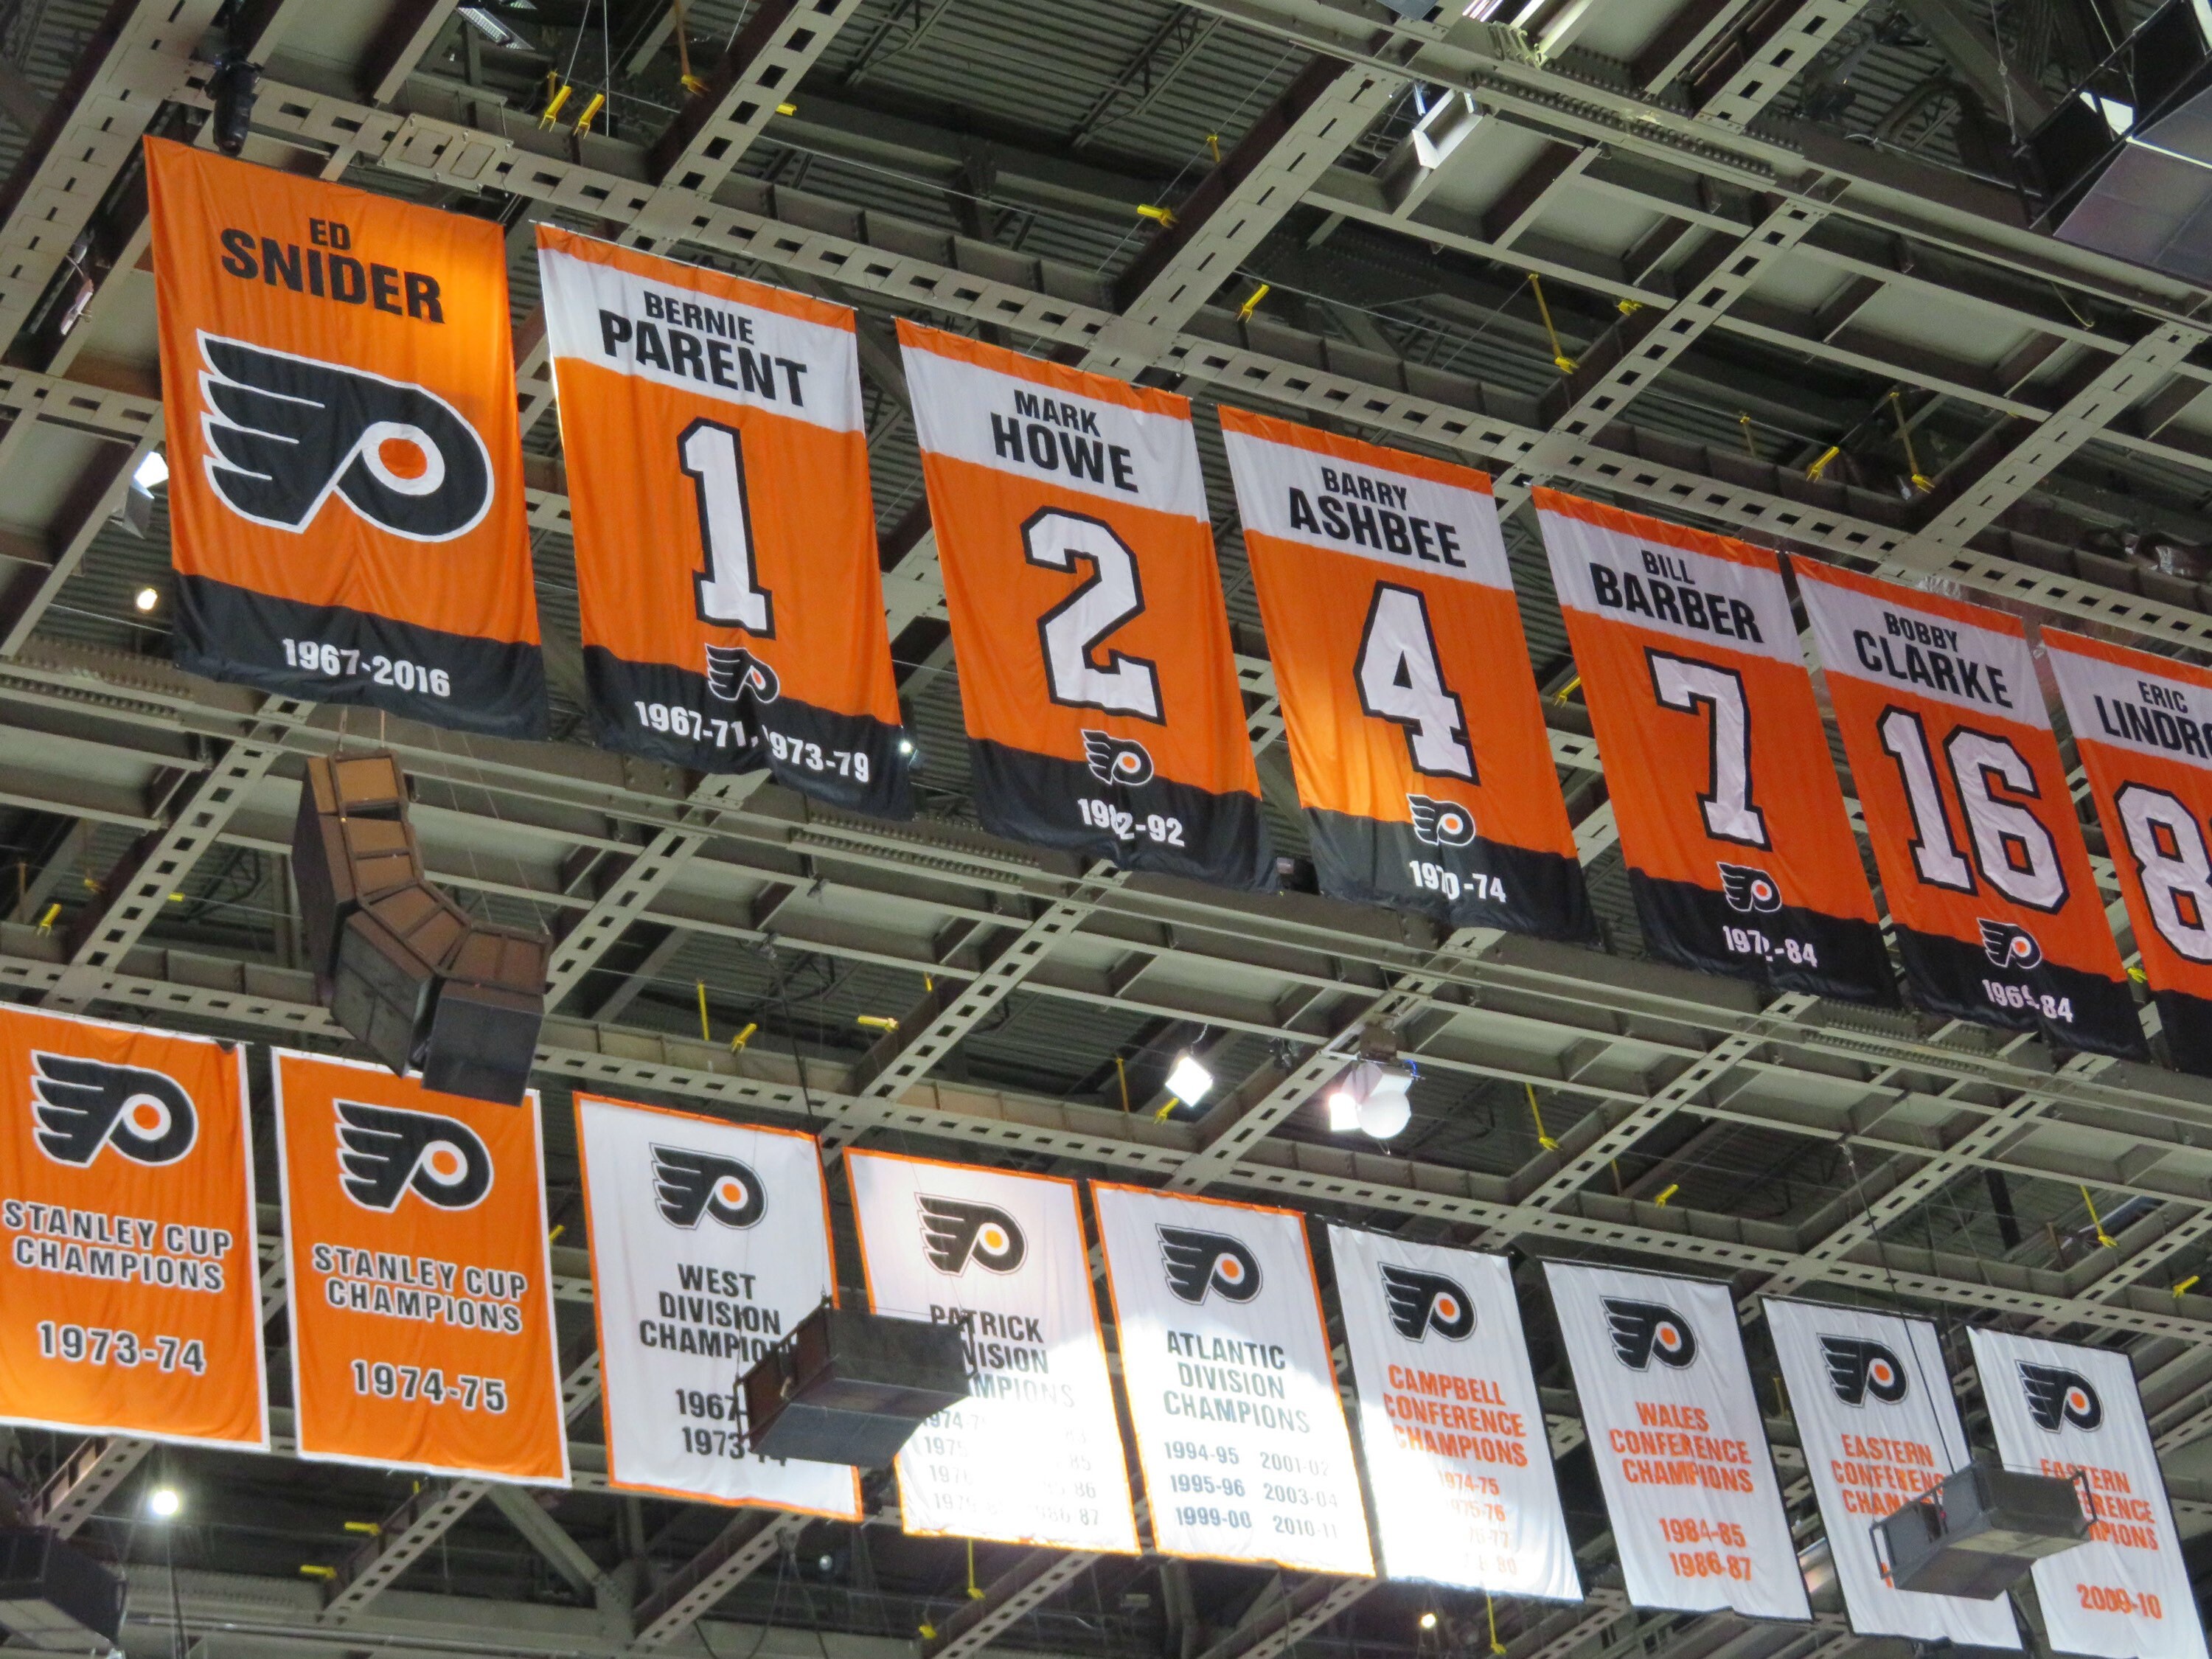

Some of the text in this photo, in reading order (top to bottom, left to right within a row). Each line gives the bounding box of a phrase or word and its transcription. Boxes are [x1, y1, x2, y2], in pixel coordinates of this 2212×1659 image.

[310, 218, 351, 251] ED
[221, 228, 445, 324] SNIDER
[644, 291, 755, 345] BERNIE
[599, 308, 807, 408] PARENT
[1014, 389, 1101, 438] MARK
[990, 411, 1139, 493] HOWE
[1321, 466, 1407, 510] BARRY
[676, 416, 776, 641] 1
[1289, 487, 1467, 568] ASHBEE
[1641, 549, 1695, 585] BILL
[1019, 505, 1166, 727] 2
[1589, 562, 1764, 643] BARBER
[1883, 611, 1958, 652] BOBBY
[282, 639, 450, 697] 1967-2016
[1353, 580, 1481, 787] 4
[1853, 629, 2013, 709] CLARKE
[2138, 681, 2188, 714] ERIC
[635, 700, 758, 748] 1967-71,
[1644, 645, 1773, 852] 7
[1876, 703, 2070, 915] 16
[1409, 860, 1506, 903] 1970-74
[2, 1199, 232, 1259] STANLEY CUP
[15, 1237, 225, 1293] CHAMPIONS
[311, 1242, 528, 1302] STANLEY CUP
[677, 1263, 757, 1300] WEST
[326, 1277, 523, 1335] CHAMPIONS
[658, 1291, 782, 1335] DIVISION
[38, 1321, 206, 1377] 1973-74
[639, 1319, 789, 1364] CHAMPIO
[960, 1339, 1049, 1374] VISION
[1166, 1330, 1286, 1370] ATLANTIC
[351, 1359, 507, 1413] 1974-75
[969, 1373, 1075, 1408] MPIONS
[1178, 1362, 1285, 1399] DIVISION
[1388, 1364, 1506, 1406] CAMPBELL
[1164, 1390, 1311, 1433] CHAMPIONS
[1383, 1391, 1527, 1438] CONFERENCE
[1635, 1402, 1709, 1432] WALES
[1164, 1441, 1329, 1477] 1994-95 2001-02
[1392, 1424, 1528, 1467] CHAMPIONS
[1610, 1429, 1752, 1464] CONFERENCE
[1841, 1433, 1935, 1467] EASTERN
[1169, 1473, 1338, 1508] 1995-96 2003-04
[1439, 1470, 1500, 1496] 1974-75
[1622, 1458, 1753, 1493] CHAMPIONS
[1831, 1460, 1944, 1496] CONFERENC
[1175, 1506, 1338, 1540] 1999-00 2010-11
[1659, 1517, 1746, 1548] 1984-85
[1669, 1551, 1752, 1581] 1986-87
[2076, 1583, 2163, 1619] 2009-10
